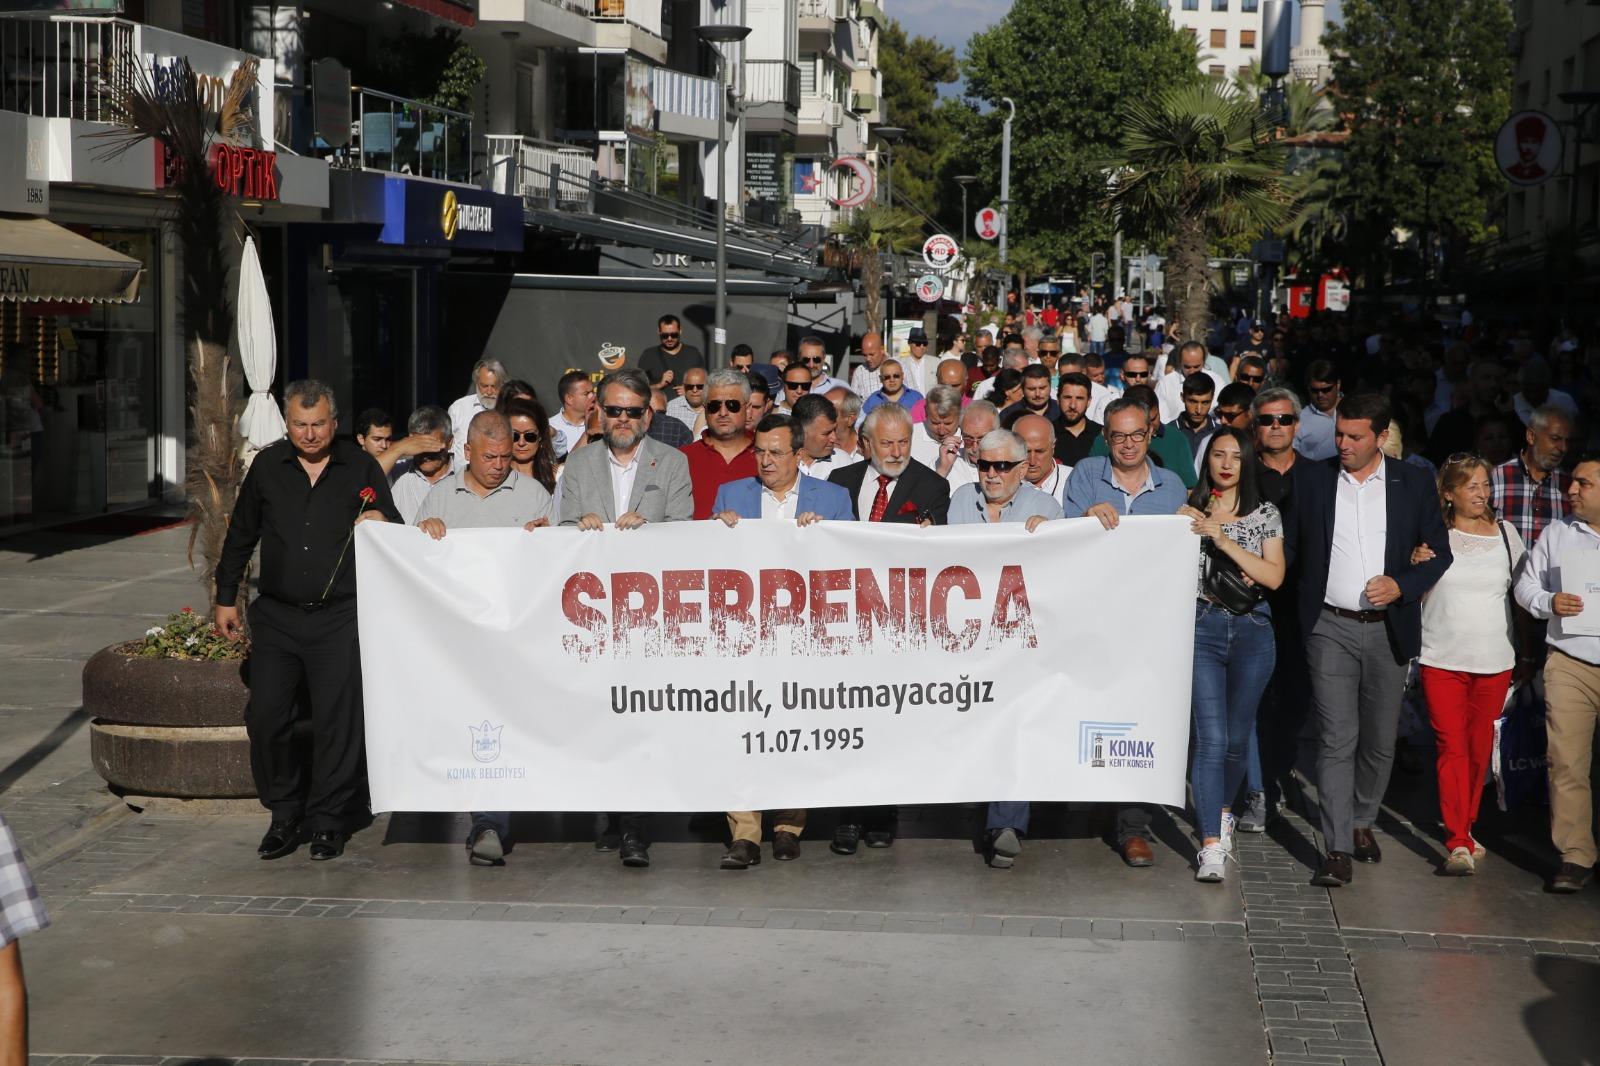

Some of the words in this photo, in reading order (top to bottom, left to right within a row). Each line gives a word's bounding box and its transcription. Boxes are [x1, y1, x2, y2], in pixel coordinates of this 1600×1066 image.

[561, 564, 1038, 660] SREBRENICA
[611, 680, 772, 718] Unutmadık,
[782, 674, 994, 714] Unutmayacağız
[741, 727, 864, 754] 11.07.1995
[1109, 740, 1155, 758] KONAK
[446, 767, 478, 780] KONAK
[1109, 759, 1126, 768] KENT
